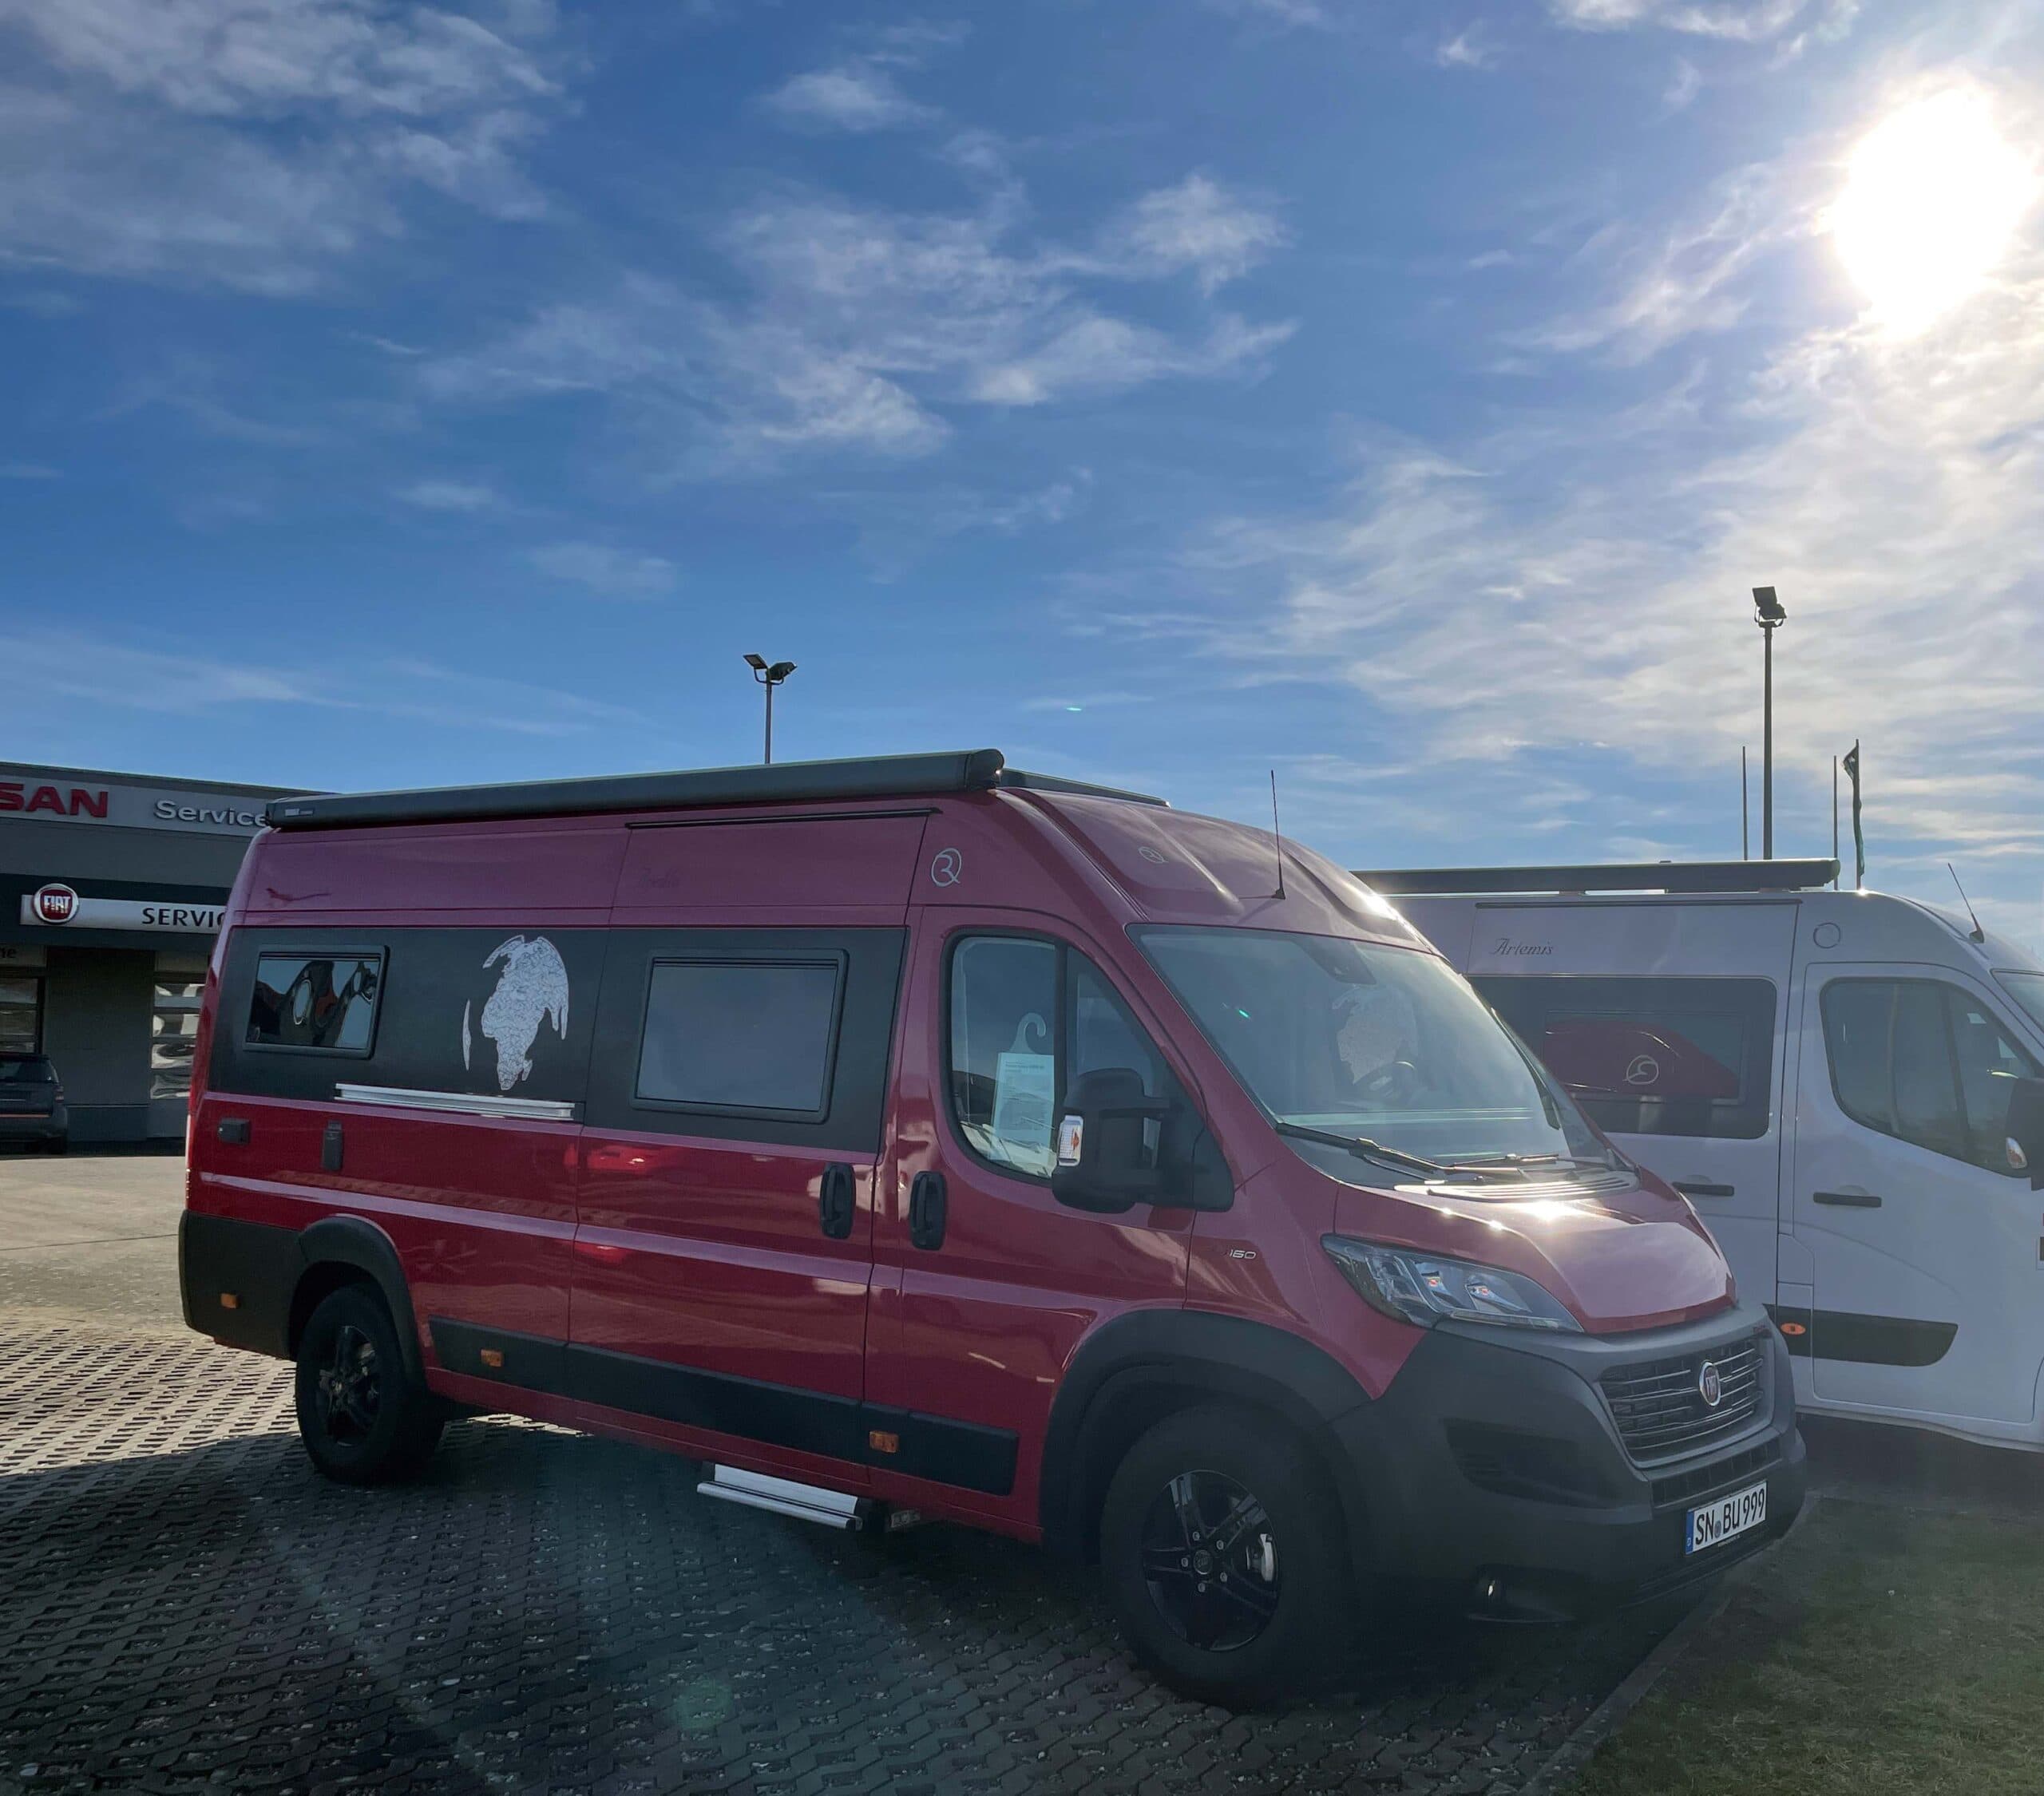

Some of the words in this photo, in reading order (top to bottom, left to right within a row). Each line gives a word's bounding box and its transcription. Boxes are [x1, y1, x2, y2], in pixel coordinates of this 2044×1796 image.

[44, 895, 71, 914] FIAT
[1489, 937, 1553, 956] Artemis
[1229, 1248, 1257, 1260] 160
[1695, 1509, 1714, 1545] SN
[1723, 1497, 1741, 1534] BU
[1743, 1488, 1765, 1525] 999
